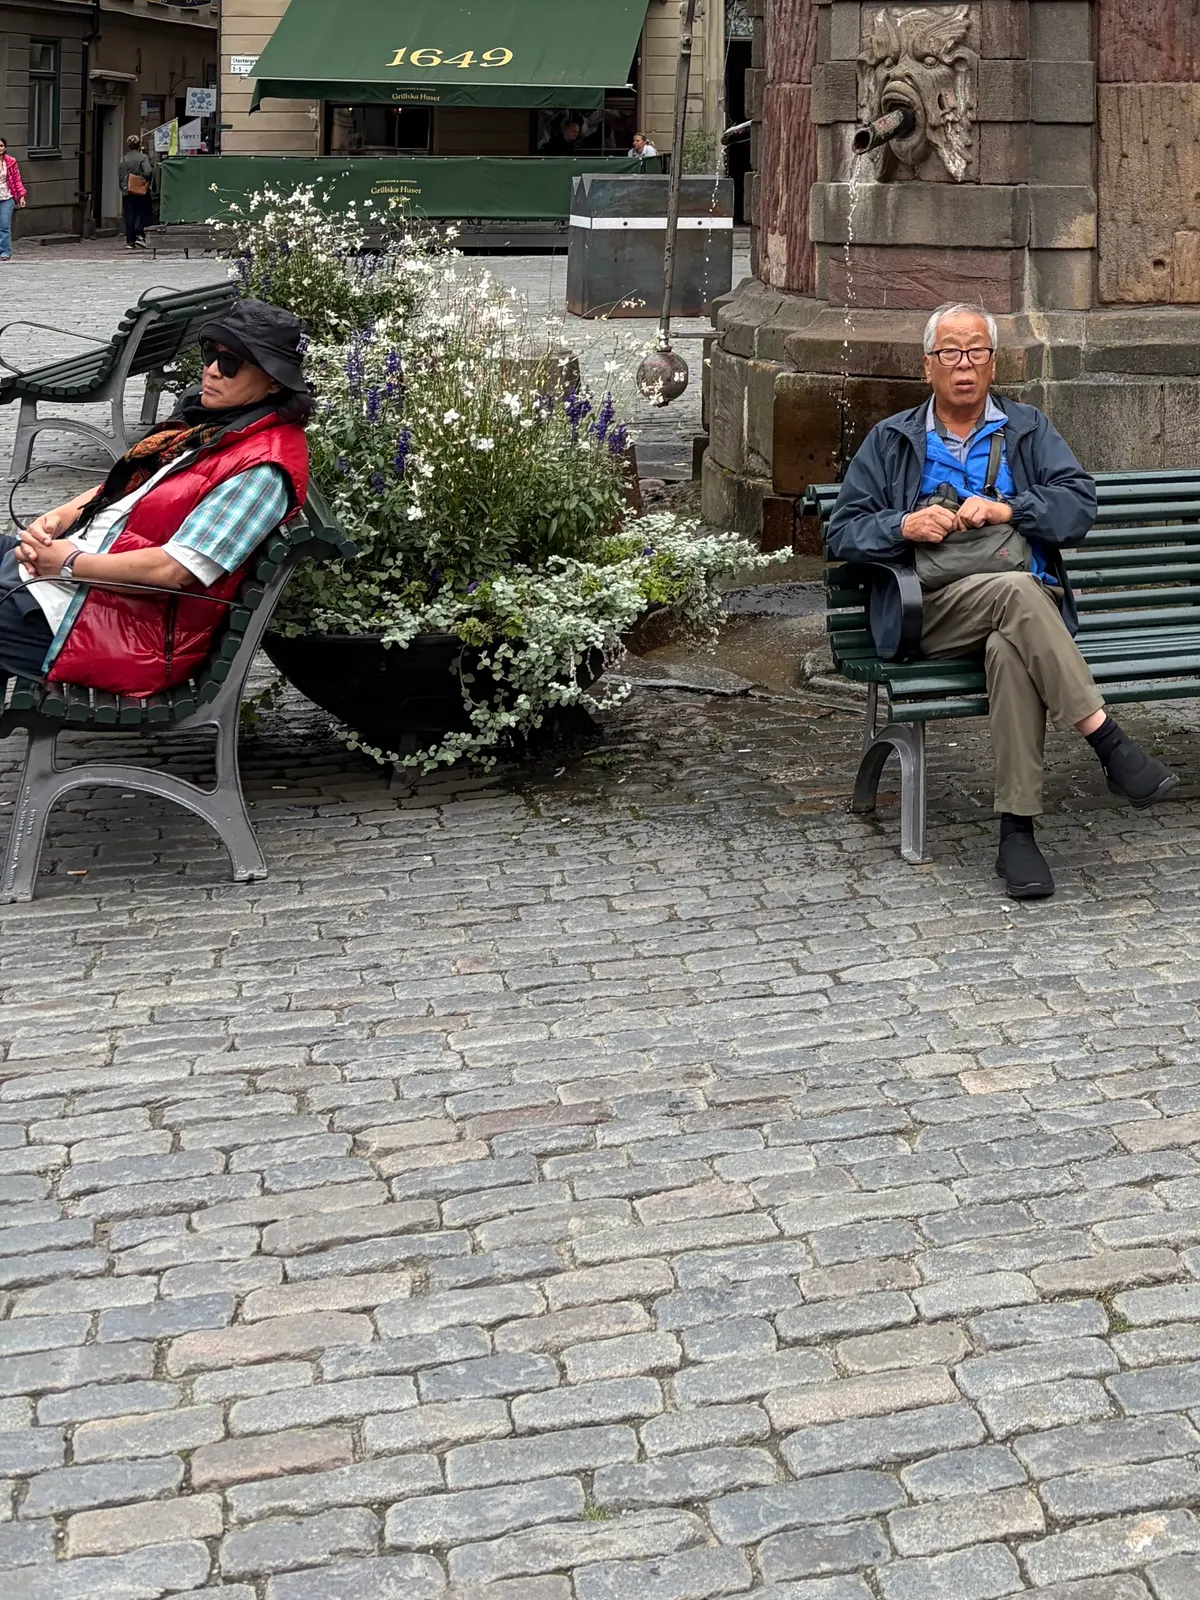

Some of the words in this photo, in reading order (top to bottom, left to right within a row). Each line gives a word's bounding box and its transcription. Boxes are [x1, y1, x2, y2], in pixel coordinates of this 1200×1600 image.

[384, 46, 514, 69] 1649
[420, 93, 440, 101] Huset
[370, 186, 399, 195] Grillska
[400, 185, 422, 194] Huset
